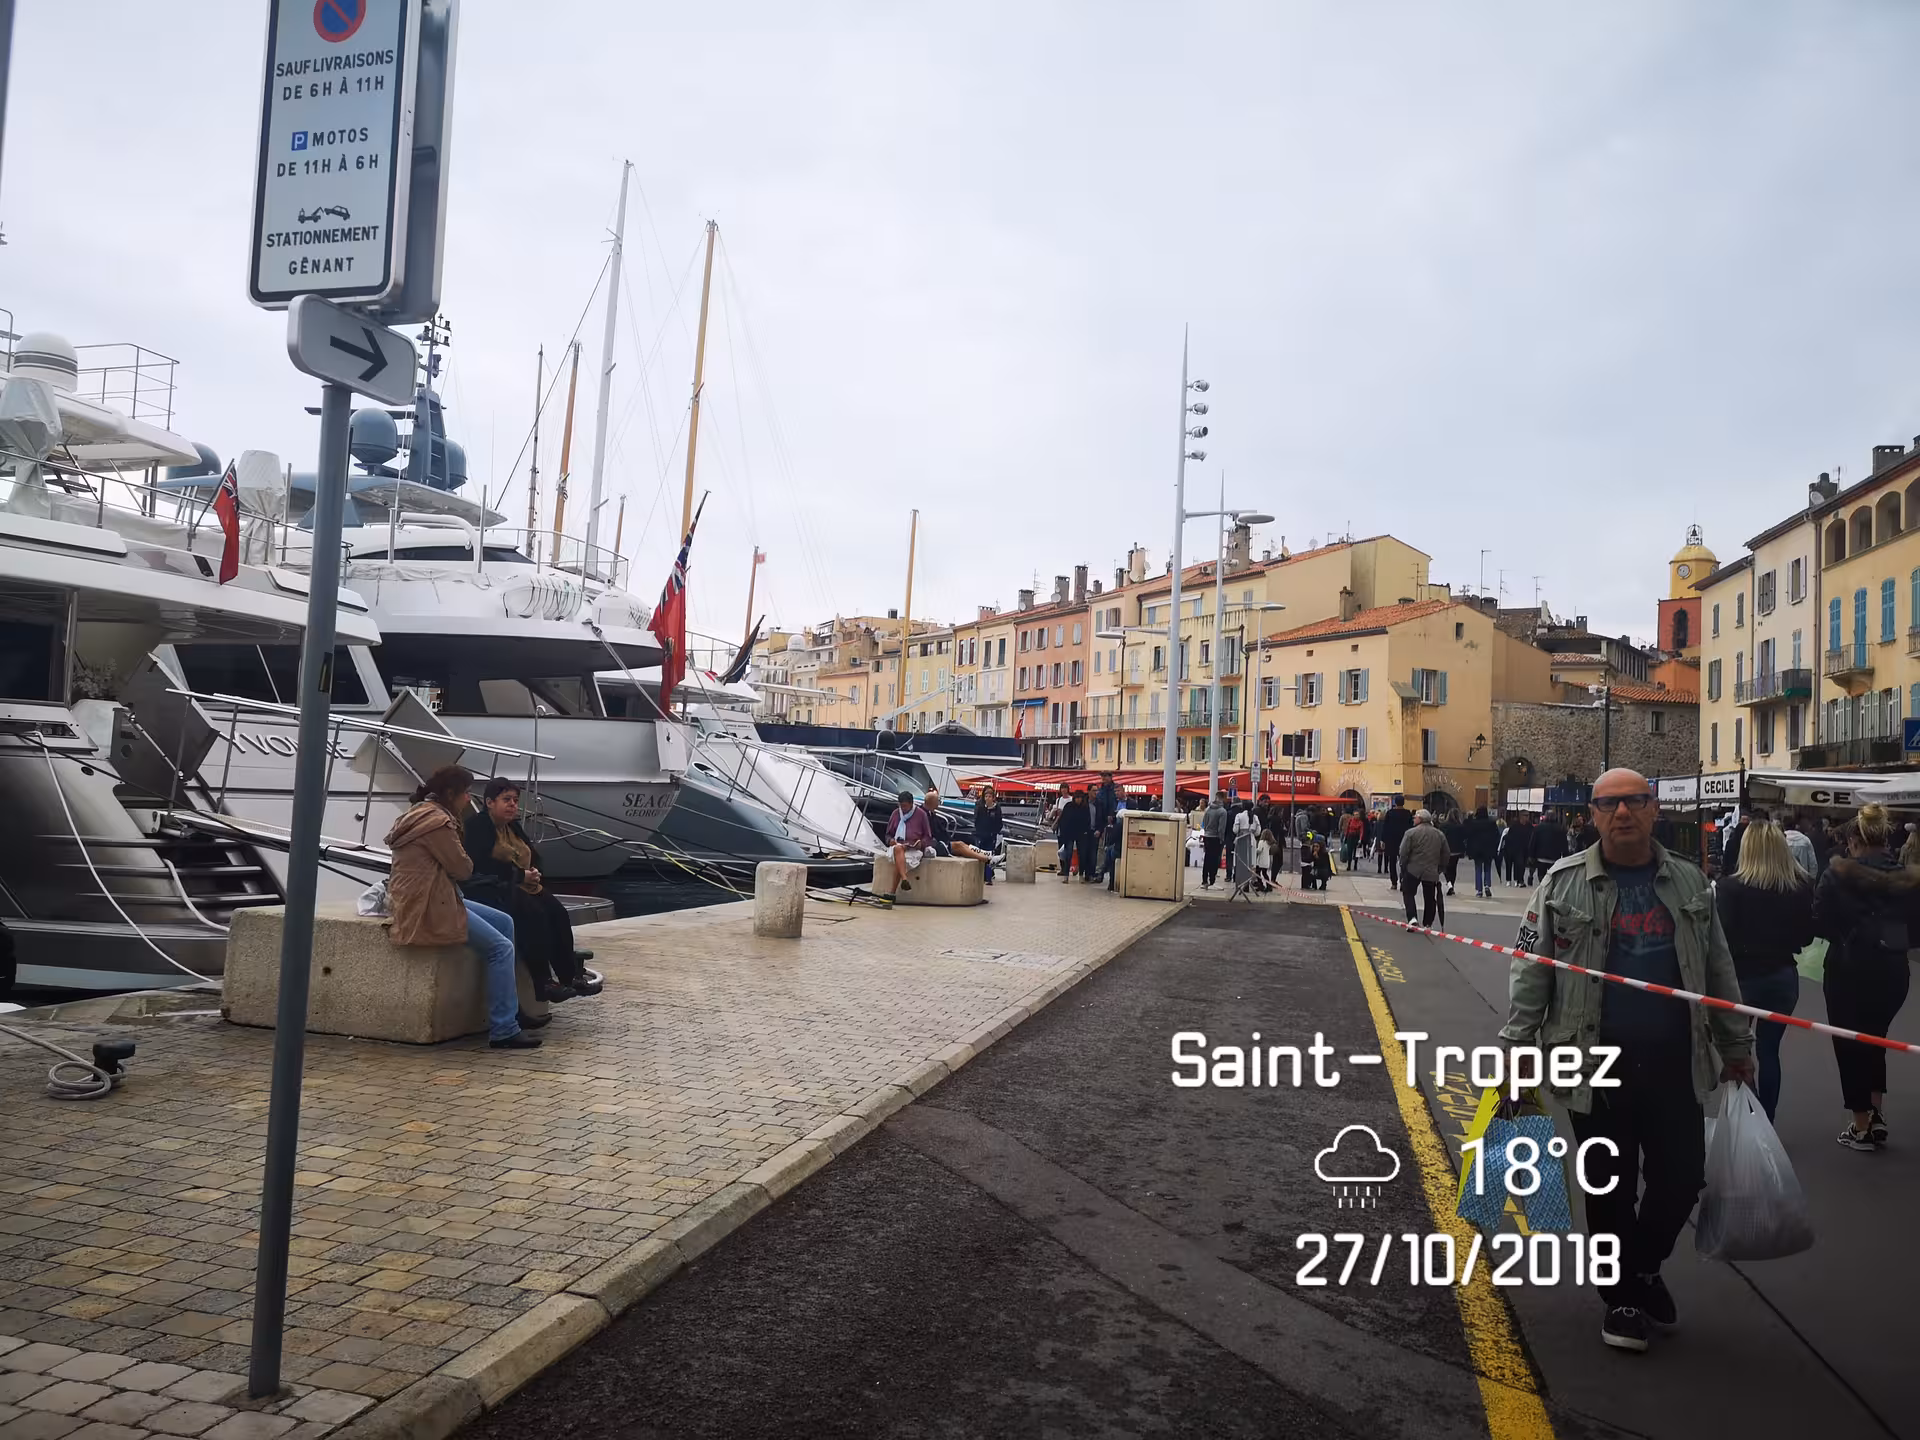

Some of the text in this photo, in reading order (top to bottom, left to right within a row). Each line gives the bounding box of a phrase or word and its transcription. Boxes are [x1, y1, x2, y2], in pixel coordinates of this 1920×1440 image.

[276, 49, 394, 78] SAUF LIVRAISONS
[283, 85, 303, 101] DE
[339, 76, 349, 95] À
[312, 127, 369, 147] MOTOS
[277, 161, 297, 178] DE
[338, 153, 348, 172] À
[265, 225, 380, 248] STATIONNEMENT
[288, 256, 355, 275] GÊNANT
[219, 730, 356, 760] YVOE
[1704, 780, 1735, 794] CECILE
[622, 792, 654, 808] SEA
